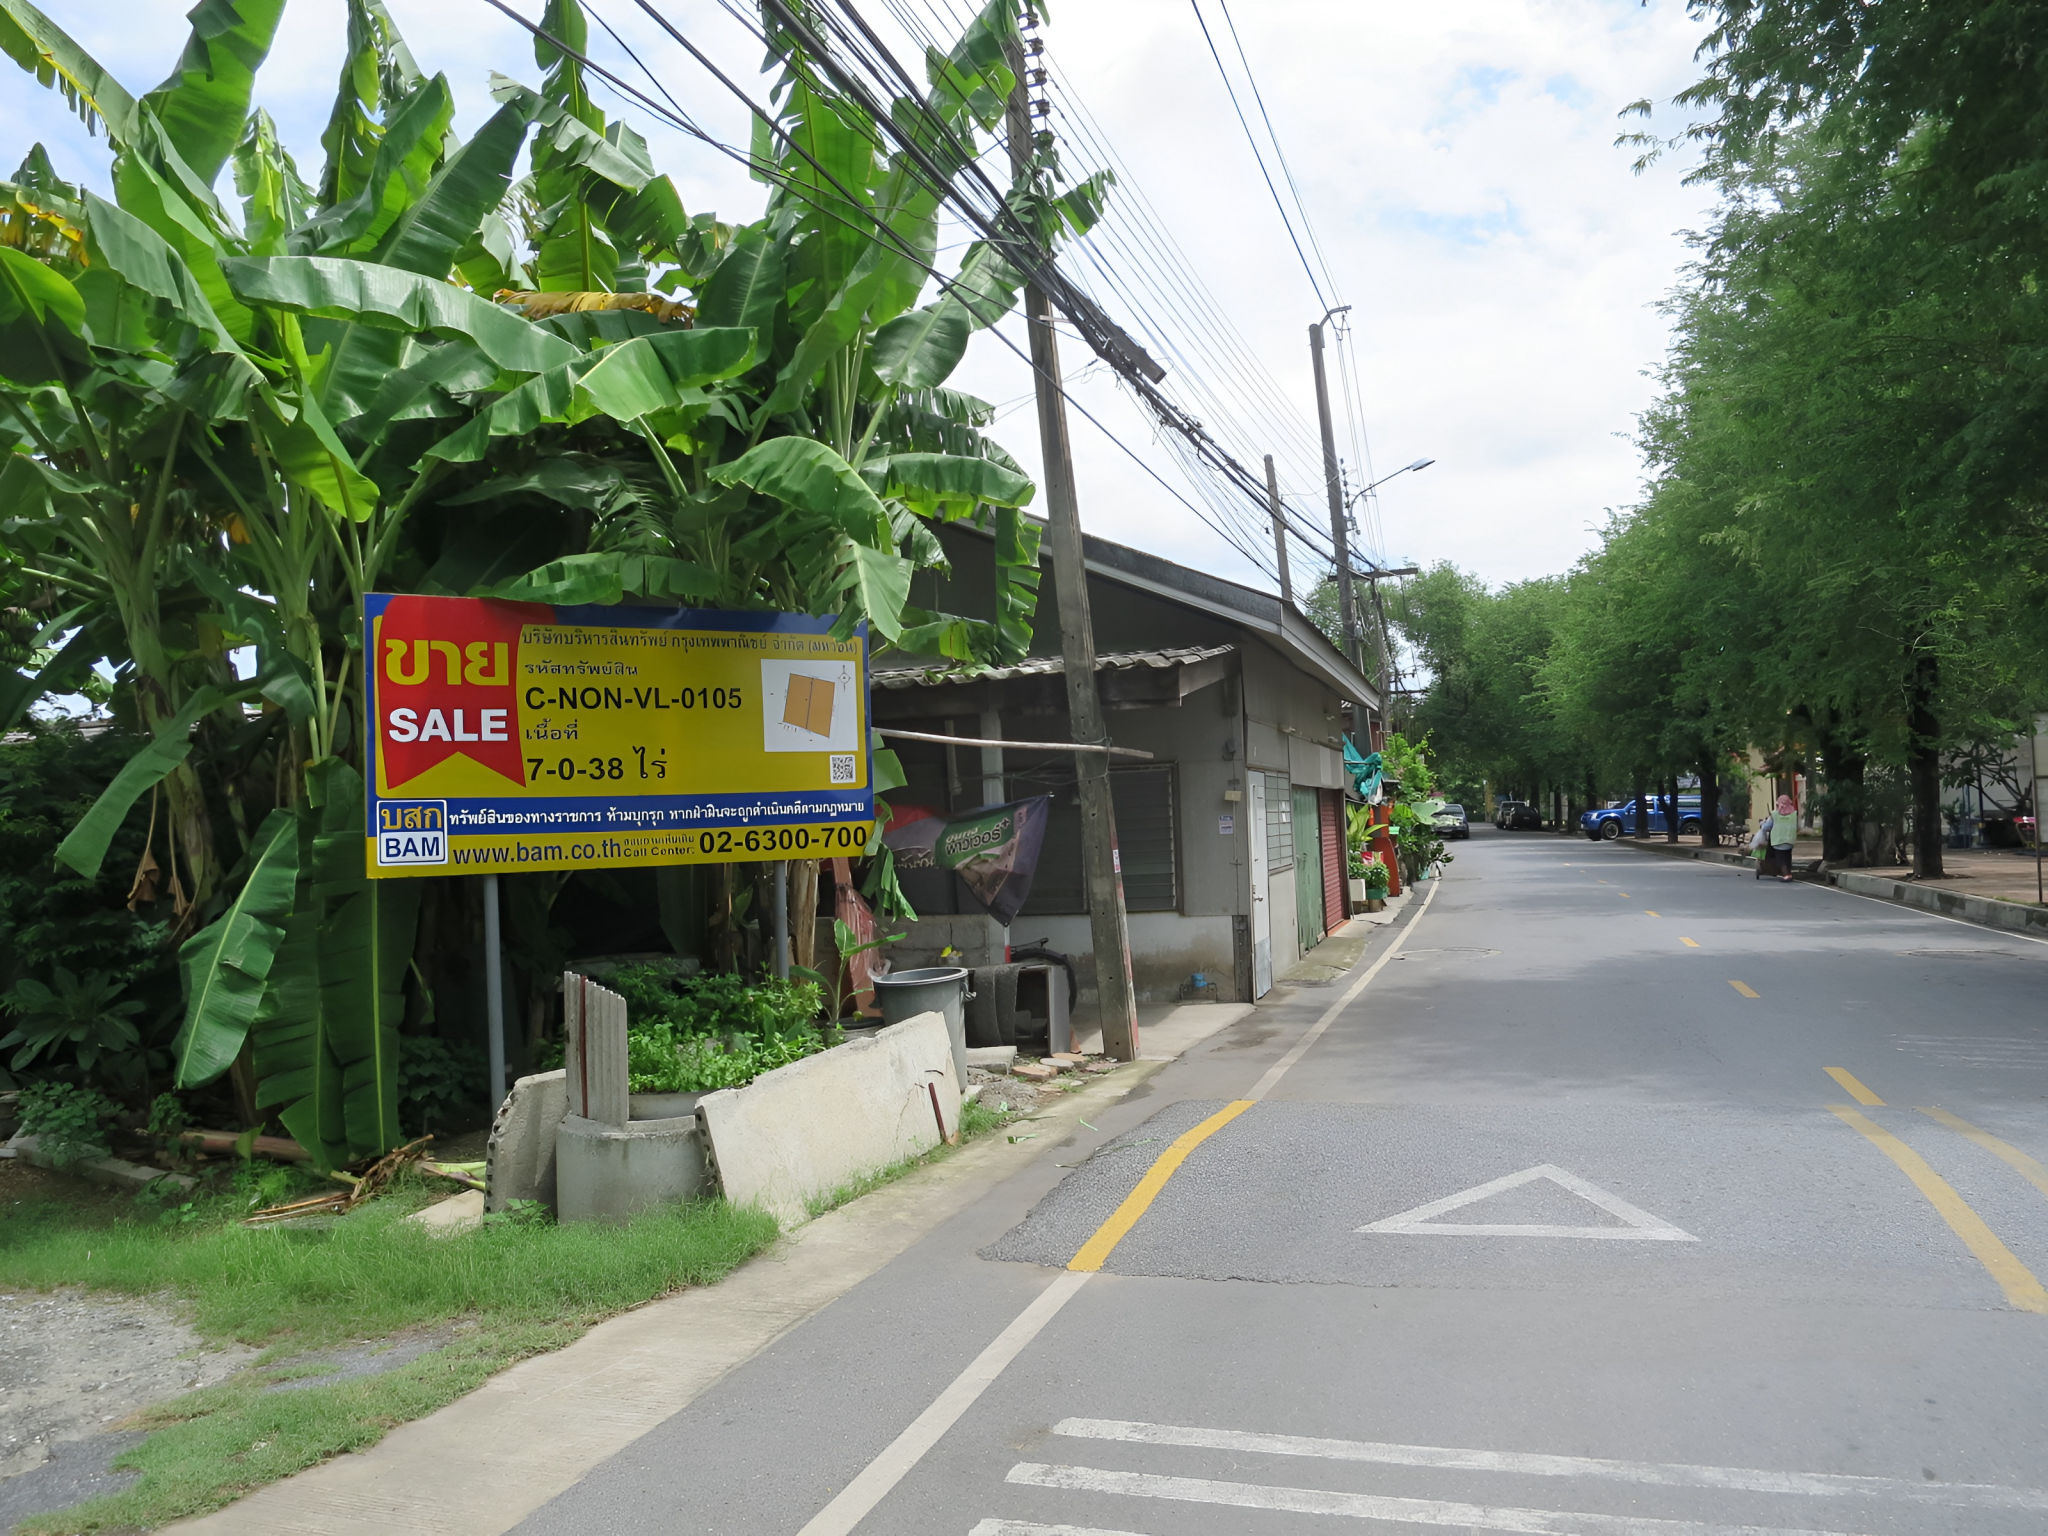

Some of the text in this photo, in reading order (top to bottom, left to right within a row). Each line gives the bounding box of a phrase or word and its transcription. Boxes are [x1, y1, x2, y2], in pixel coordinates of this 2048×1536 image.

[385, 638, 509, 687] ขาย
[524, 659, 638, 676] รหัสทรัพย์สิน
[525, 686, 743, 710] C-NON-VL-0105
[388, 707, 509, 743] SALE
[525, 718, 578, 740] เนื้อที่
[526, 745, 668, 781] 7-0-38 ไร่
[380, 805, 443, 830] บสก
[449, 808, 602, 826] ทรัพย์สินของทางราชการ
[606, 806, 665, 826] ห้ามบุกรุก
[385, 836, 441, 858] BAM
[453, 838, 622, 865] www.bam.co.th
[699, 826, 868, 854] 02-6300-700
[623, 847, 647, 858] Call
